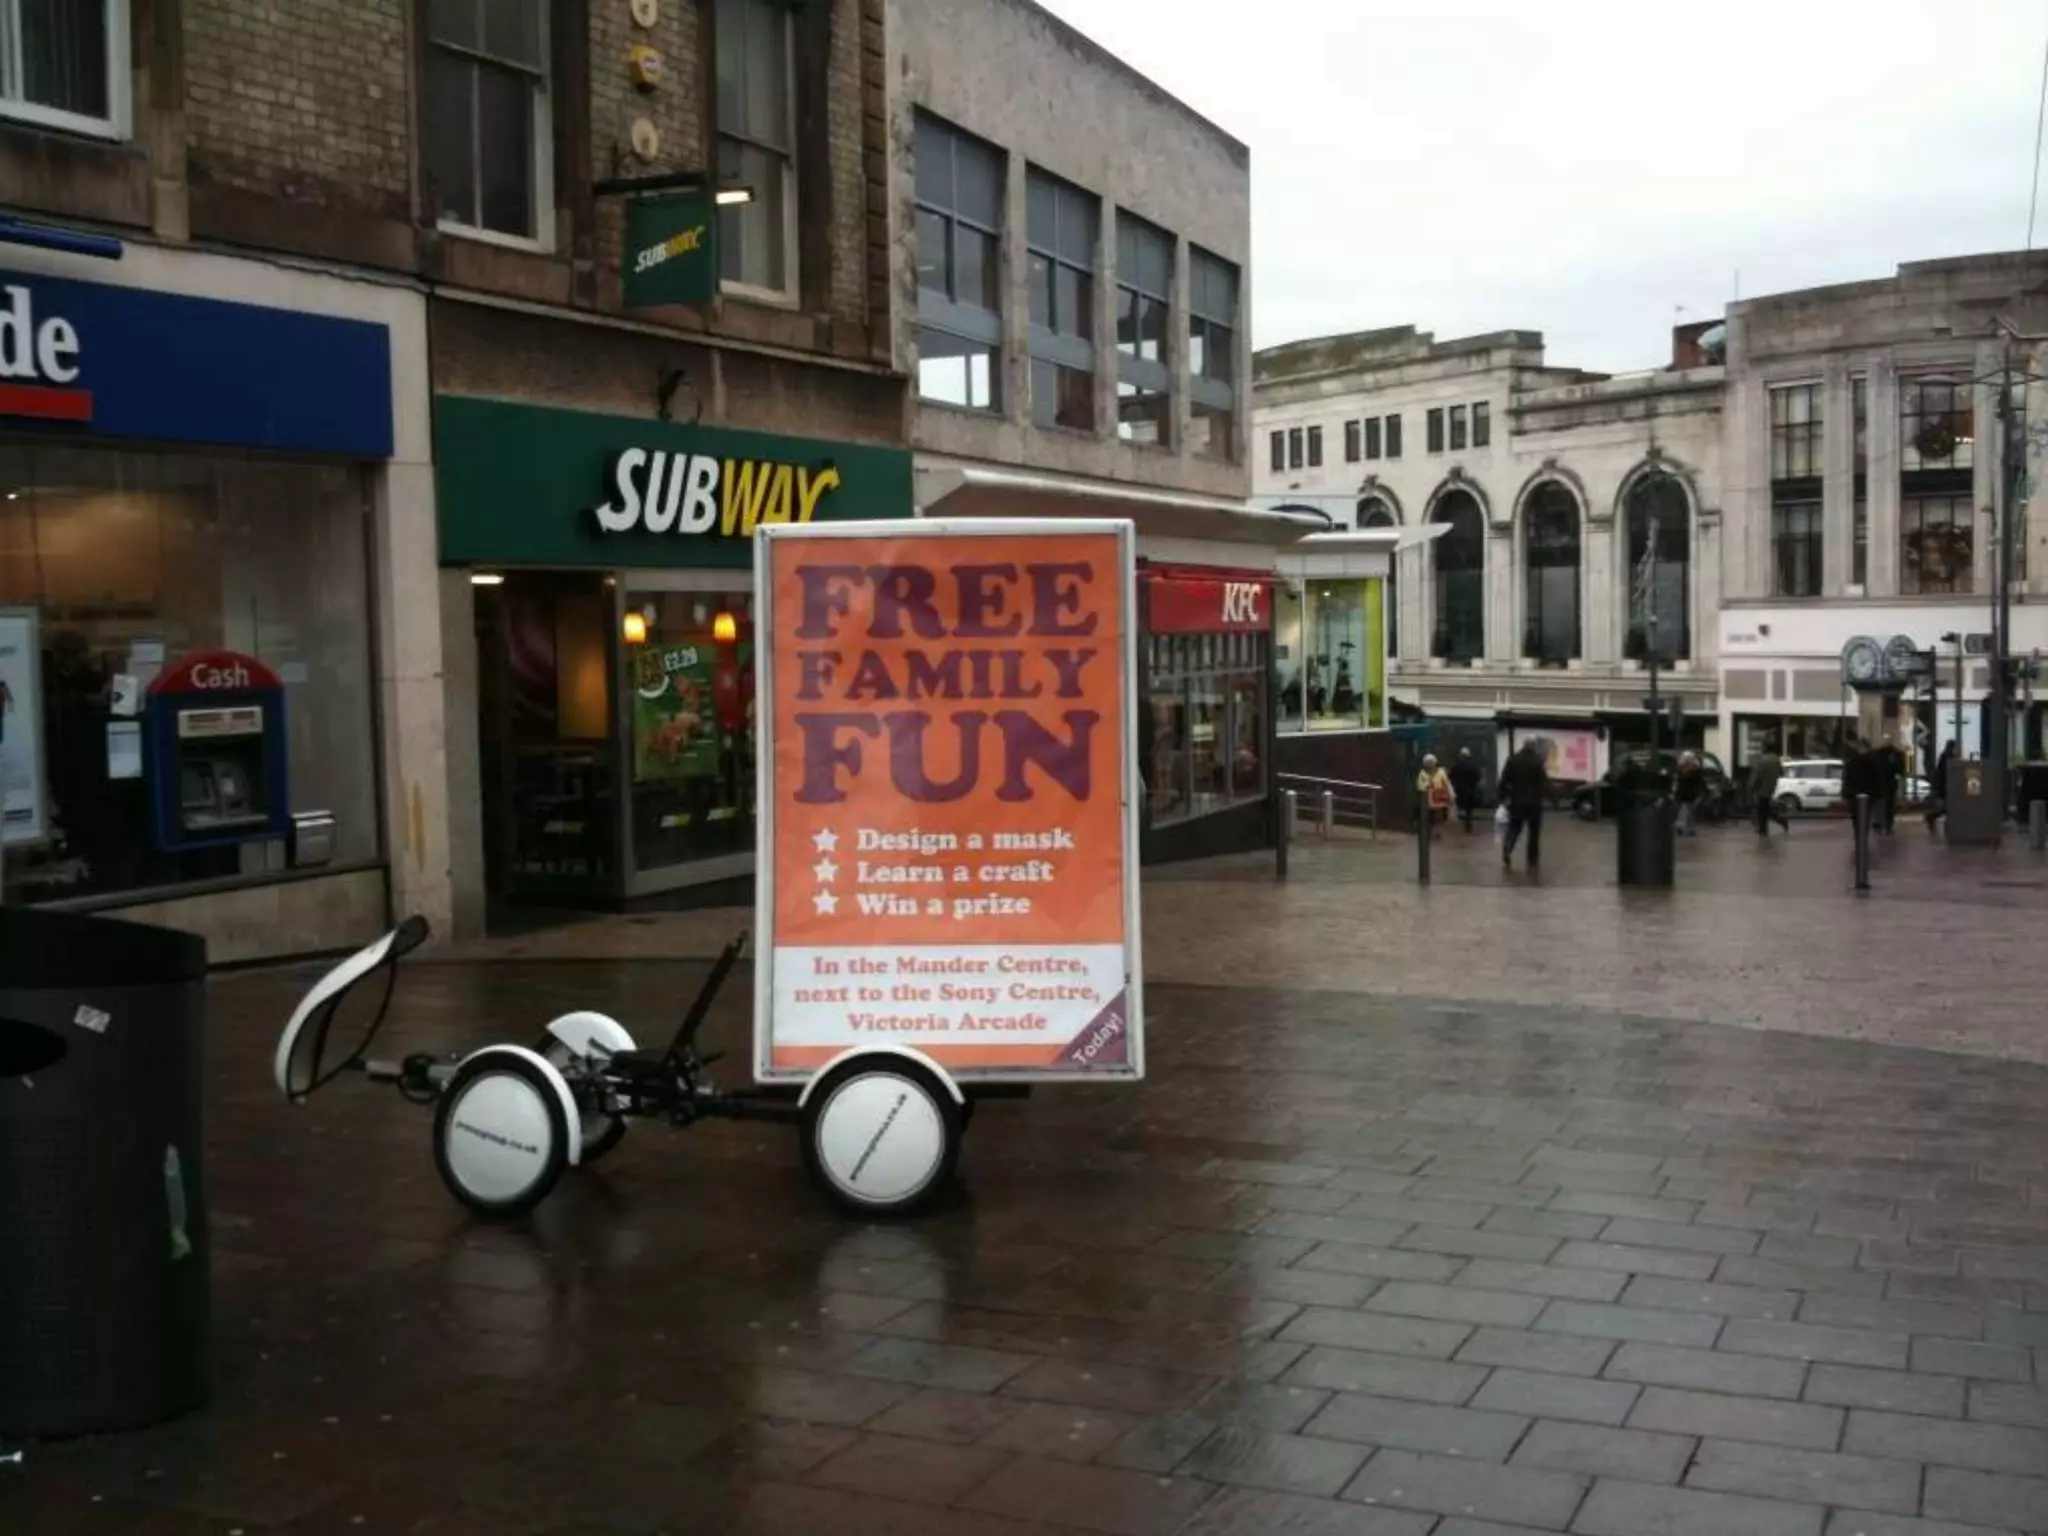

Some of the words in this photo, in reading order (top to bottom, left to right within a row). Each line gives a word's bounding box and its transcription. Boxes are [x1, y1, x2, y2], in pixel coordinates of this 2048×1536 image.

[634, 225, 706, 273] SUBWAY
[0, 286, 80, 383] de
[596, 447, 840, 537] SUBWAY
[795, 561, 1098, 639] FREE
[1222, 582, 1262, 622] KFC
[190, 661, 250, 689] Cash
[795, 648, 1097, 700] FAMILY
[793, 709, 1100, 804] FUN
[857, 828, 957, 855] Design
[967, 834, 983, 850] a
[993, 827, 1075, 850] mask
[857, 861, 943, 883] Learn
[953, 867, 969, 882] a
[979, 860, 1054, 882] craft
[857, 893, 918, 915] Win
[927, 900, 944, 915] a
[953, 892, 1031, 920] prize
[813, 956, 843, 975] In
[847, 955, 888, 975] the
[896, 955, 989, 975] Mander
[996, 954, 1089, 977] Centre,
[794, 985, 849, 1003] next
[857, 985, 883, 1002] to
[891, 983, 932, 1002] the
[938, 983, 1000, 1005] Sony
[1008, 981, 1099, 1004] Centre,
[847, 1012, 950, 1032] Victoria
[958, 1011, 1047, 1031] Arcade
[1071, 1012, 1124, 1065] Today!
